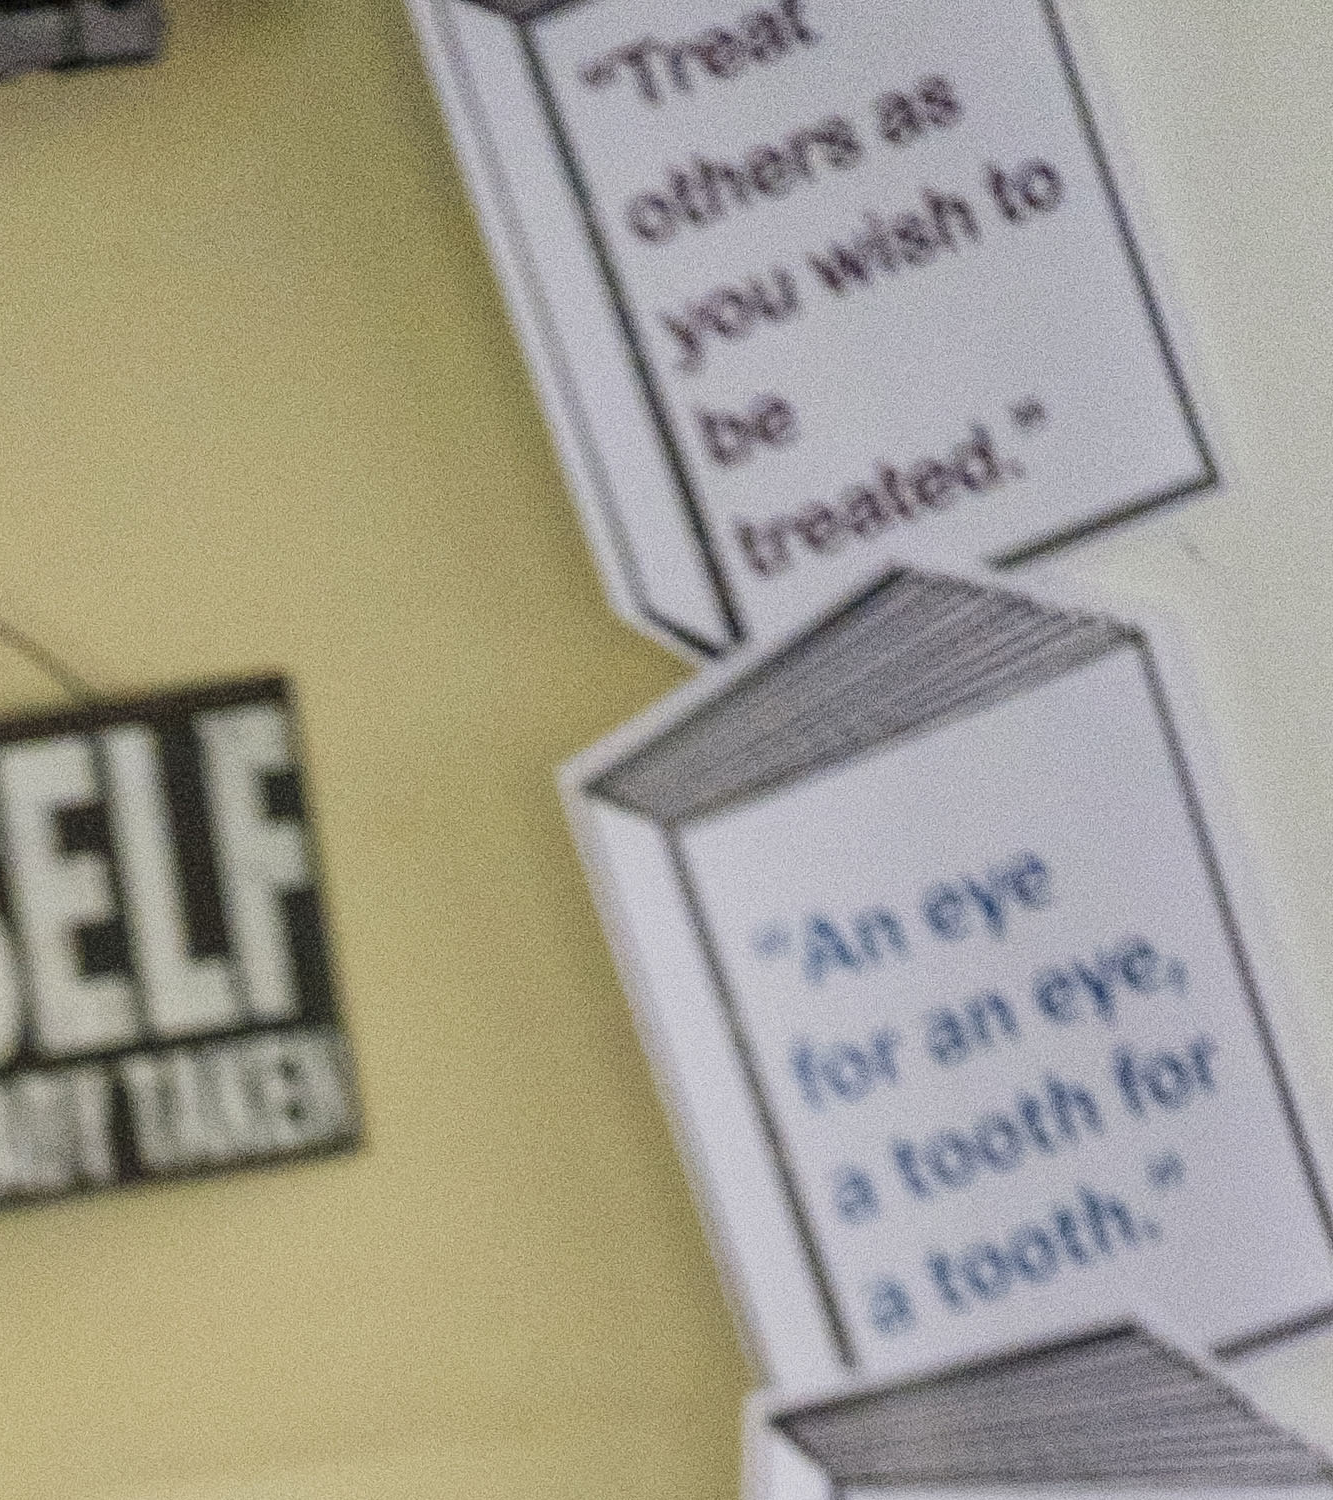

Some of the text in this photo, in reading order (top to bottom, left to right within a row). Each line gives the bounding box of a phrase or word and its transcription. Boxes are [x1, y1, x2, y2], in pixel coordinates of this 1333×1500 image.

[625, 73, 963, 246] others as
[663, 157, 1065, 372] you wish to
[698, 396, 795, 468] be
[923, 851, 1052, 940] eye
[790, 1029, 899, 1112] for
[929, 990, 1019, 1067] an
[835, 1036, 1219, 1226] a tooth for
[868, 1276, 916, 1338] a
